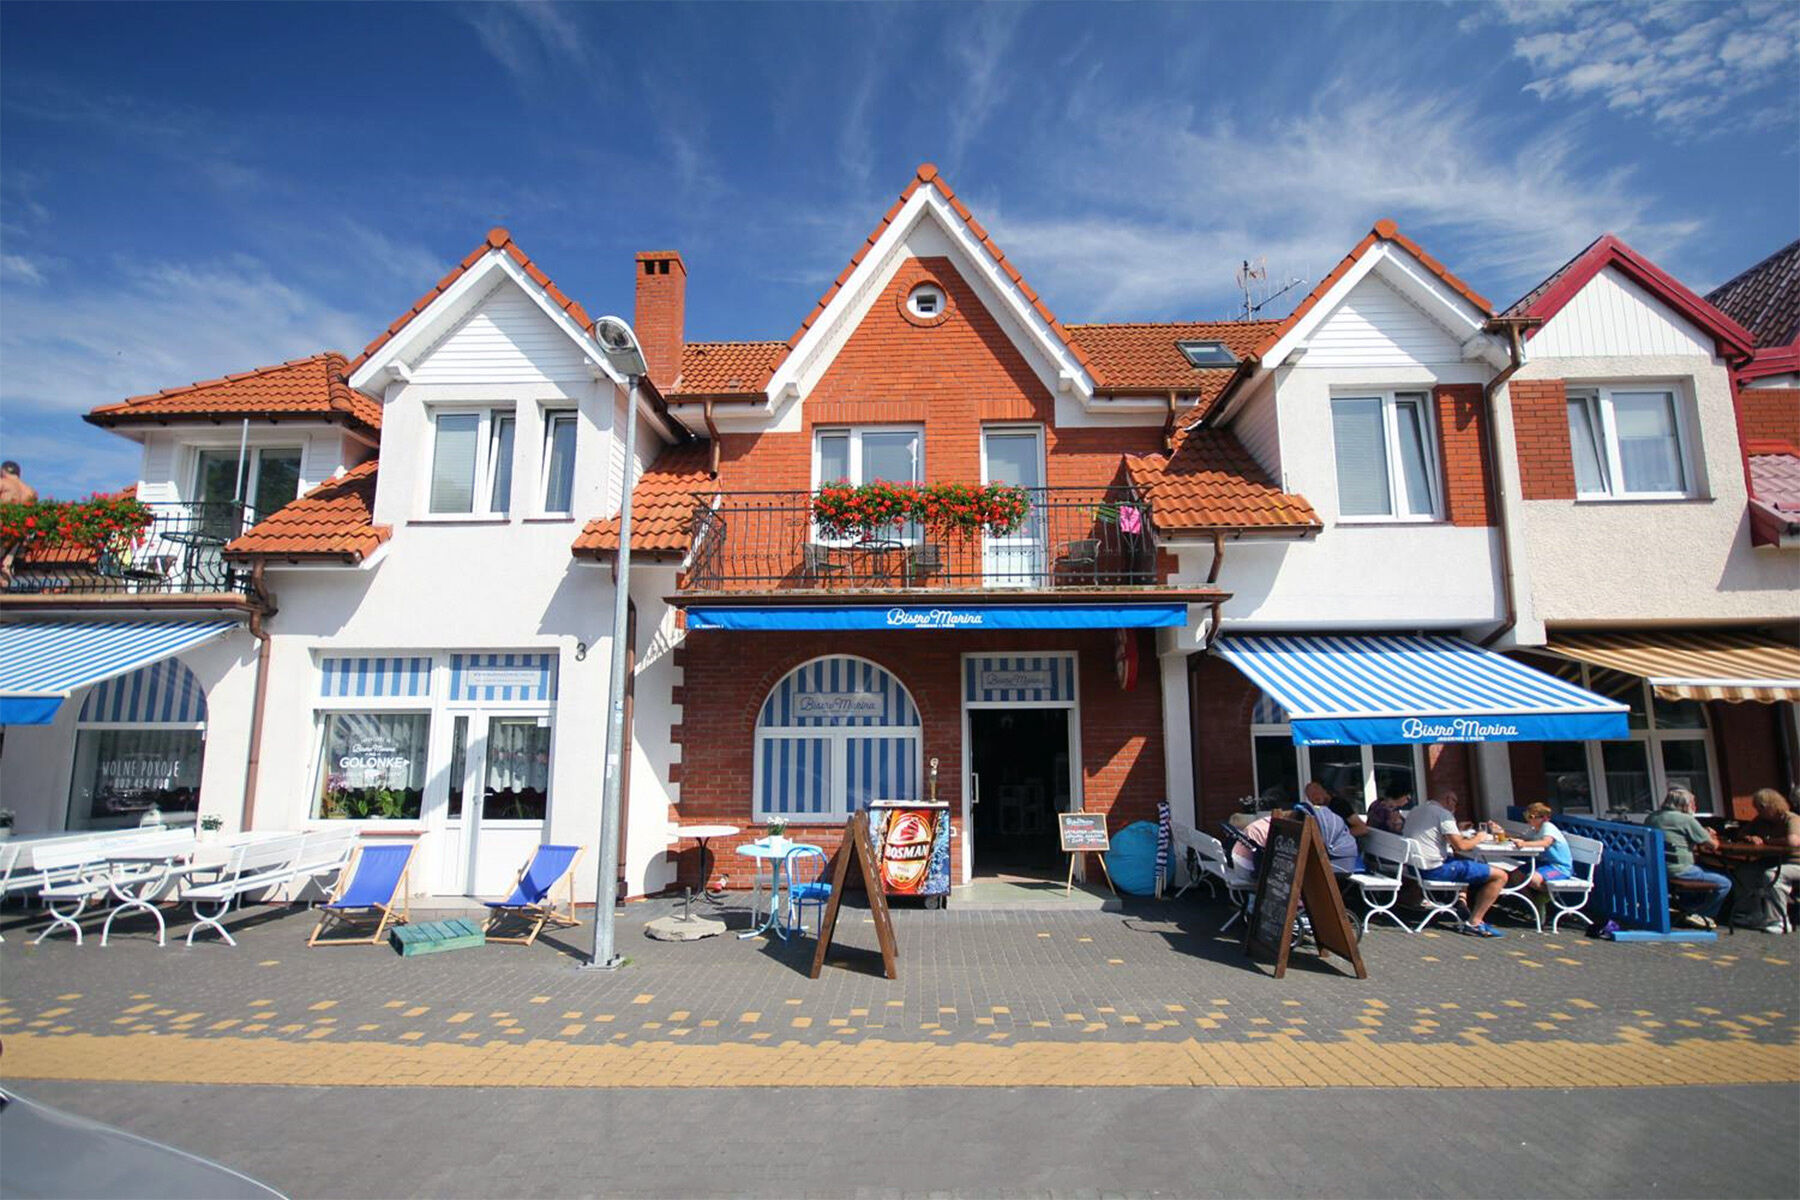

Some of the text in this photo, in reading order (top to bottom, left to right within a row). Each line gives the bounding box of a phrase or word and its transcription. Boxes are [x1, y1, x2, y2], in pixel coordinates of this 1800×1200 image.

[887, 608, 983, 625] Bistro Marina
[576, 643, 587, 661] 3
[800, 697, 834, 711] Bistro
[1402, 718, 1519, 739] Bistro Marina
[102, 761, 179, 777] WOLNE POKOJE
[886, 844, 927, 859] BOSMAN
